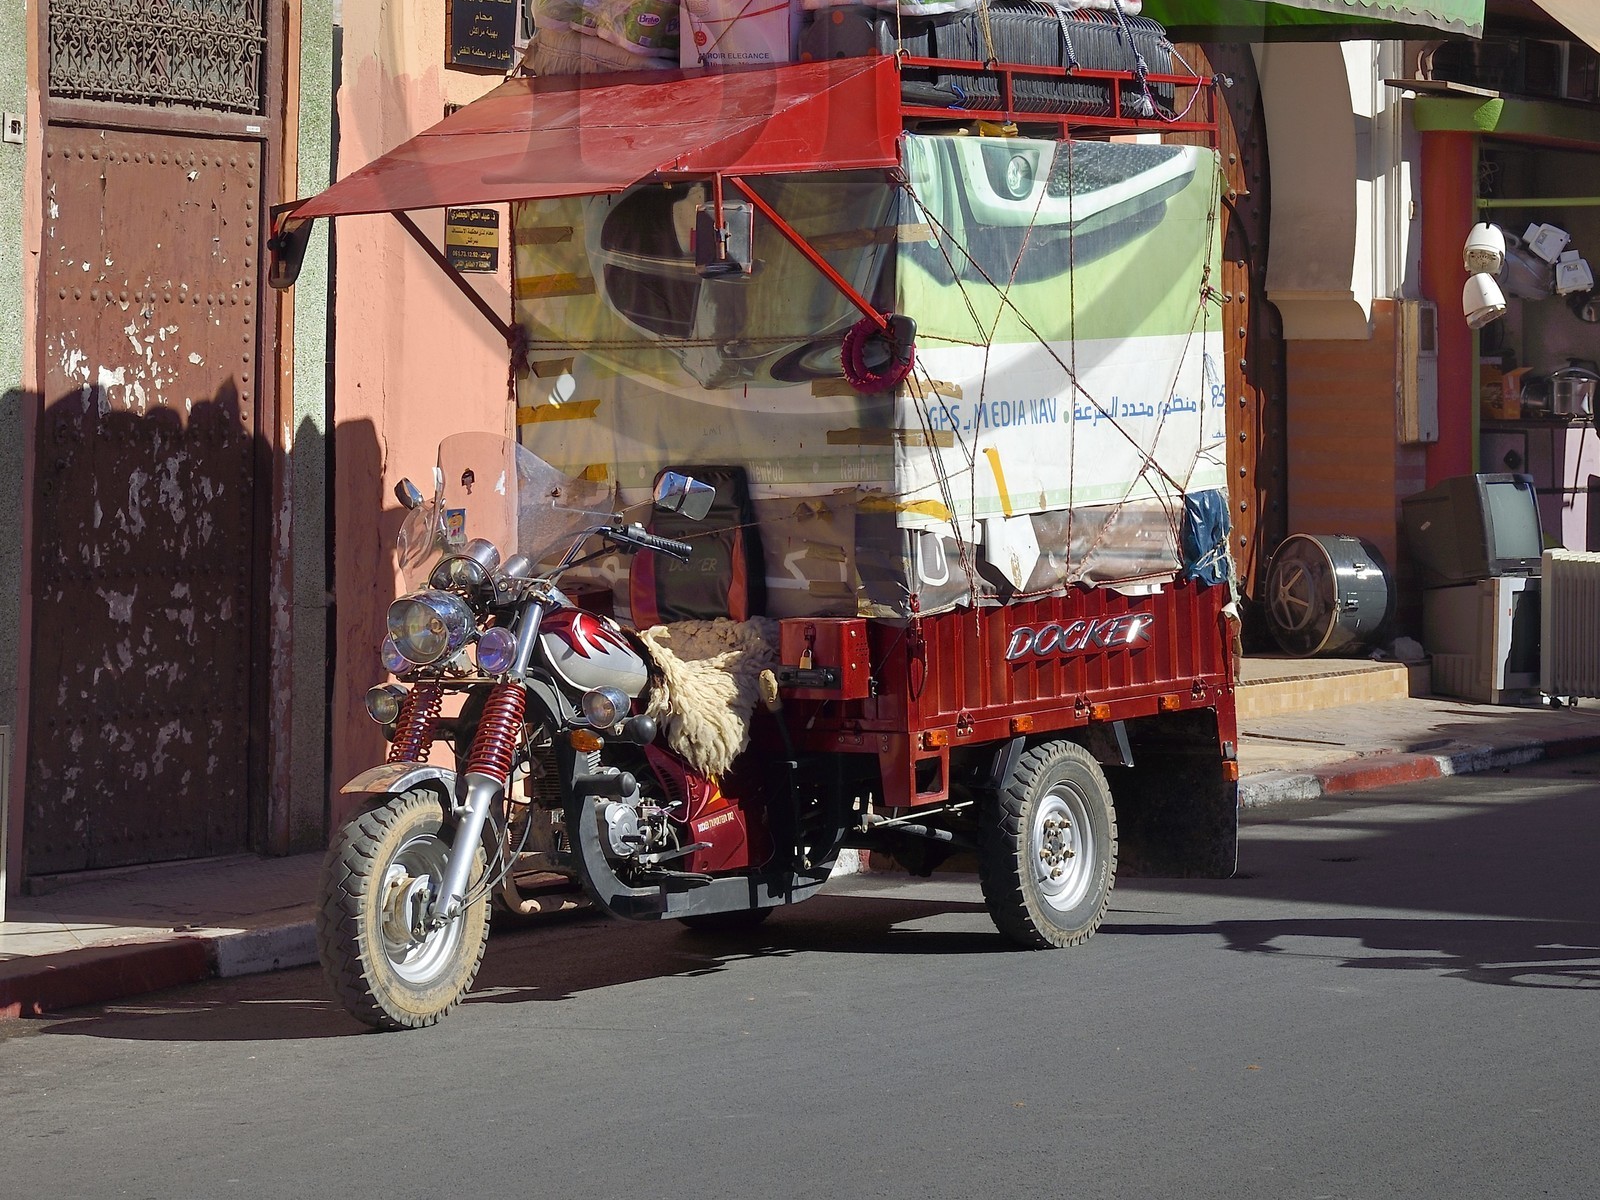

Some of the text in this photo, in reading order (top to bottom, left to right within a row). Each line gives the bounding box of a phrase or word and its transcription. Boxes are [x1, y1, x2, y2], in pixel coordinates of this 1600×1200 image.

[474, 12, 493, 23] محام
[468, 25, 485, 37] مراكش
[727, 52, 770, 60] ELEGANCE
[928, 404, 960, 431] GPS
[1029, 397, 1057, 425] NAV
[1074, 396, 1118, 427] السرعة
[1121, 402, 1154, 418] محدد
[748, 460, 784, 482] NewPub
[839, 458, 878, 481] NewPub
[1005, 613, 1154, 660] DOCKER
